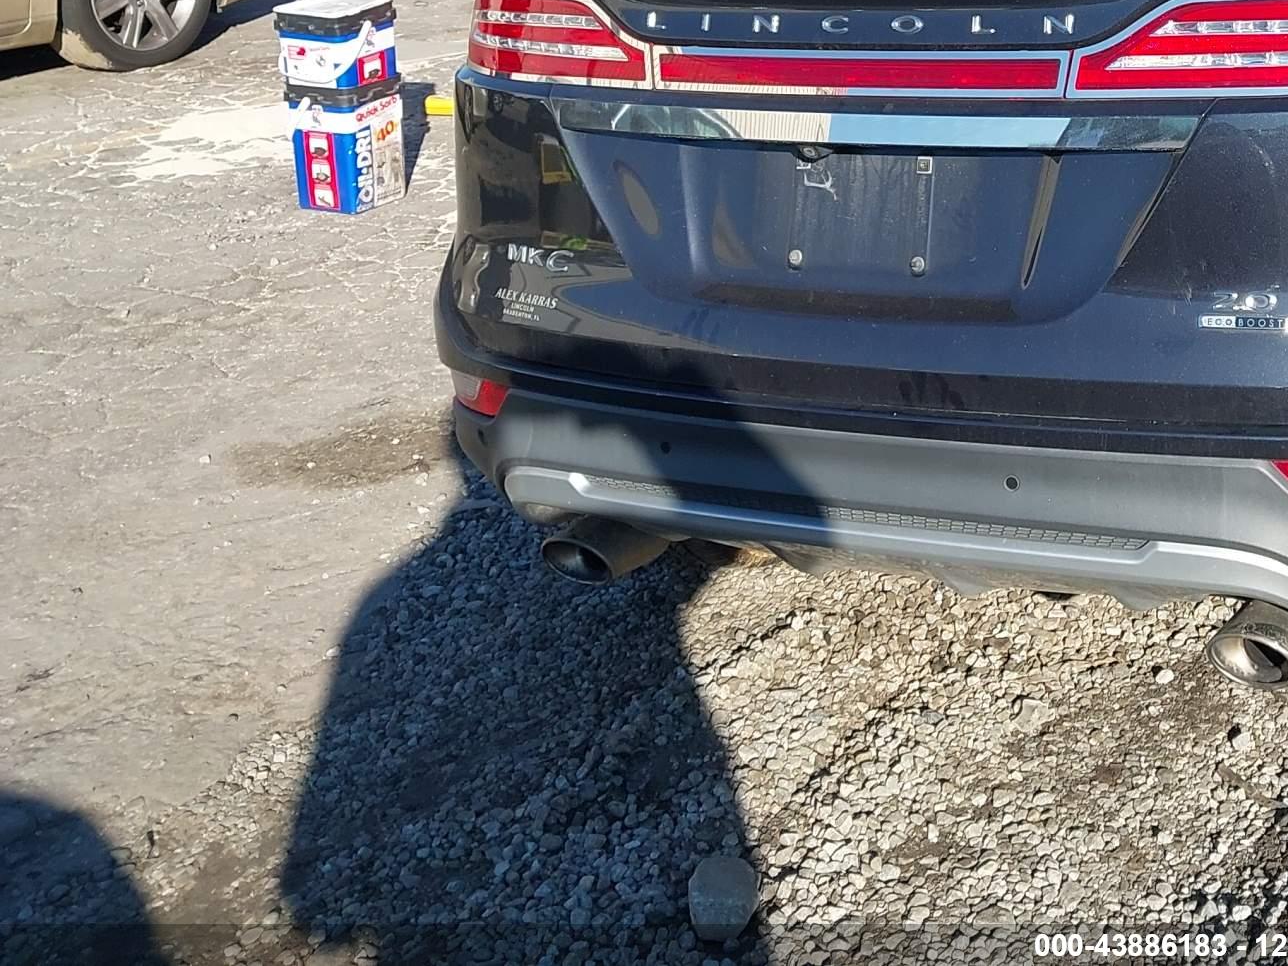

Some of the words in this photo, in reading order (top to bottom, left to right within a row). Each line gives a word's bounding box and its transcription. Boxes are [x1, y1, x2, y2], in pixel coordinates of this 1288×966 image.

[647, 11, 1074, 34] LINCOLN
[507, 243, 575, 272] MKC
[495, 288, 519, 301] ALEX
[519, 292, 559, 309] KARRAS
